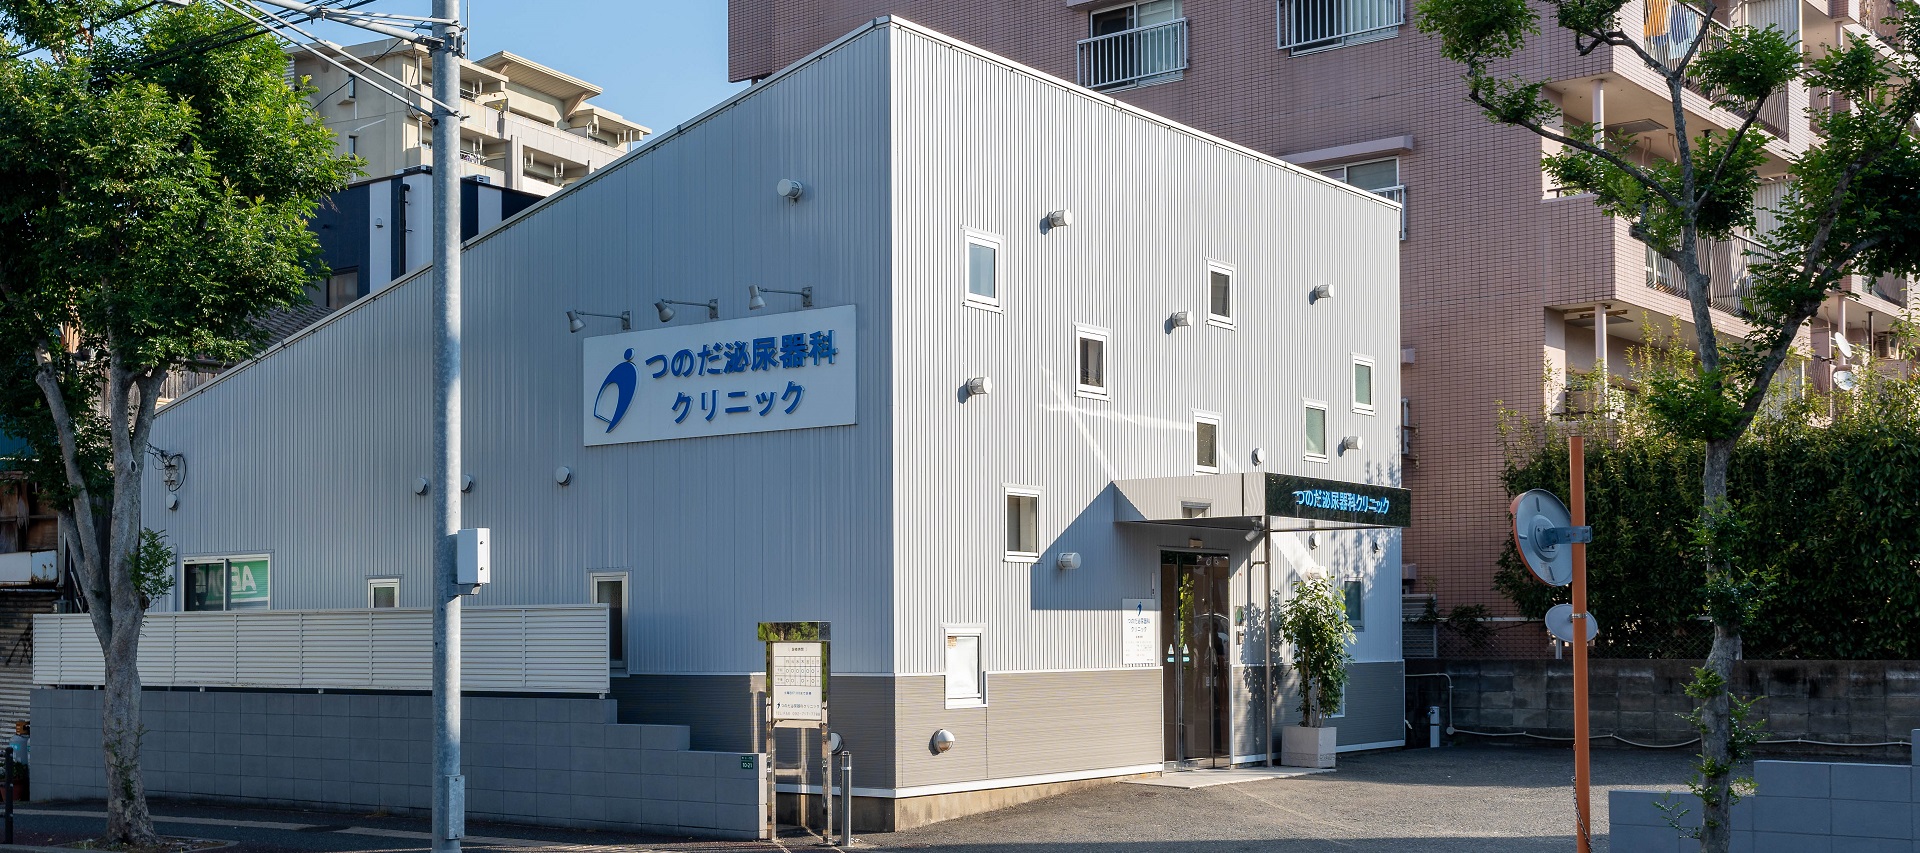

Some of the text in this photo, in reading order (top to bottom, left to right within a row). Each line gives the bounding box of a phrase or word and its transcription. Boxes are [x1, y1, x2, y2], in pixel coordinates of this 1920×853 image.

[645, 329, 838, 379] つのだ泌尿器科
[671, 381, 805, 424] クリニック
[1292, 489, 1390, 514] つのだ泌尿器科クリニック
